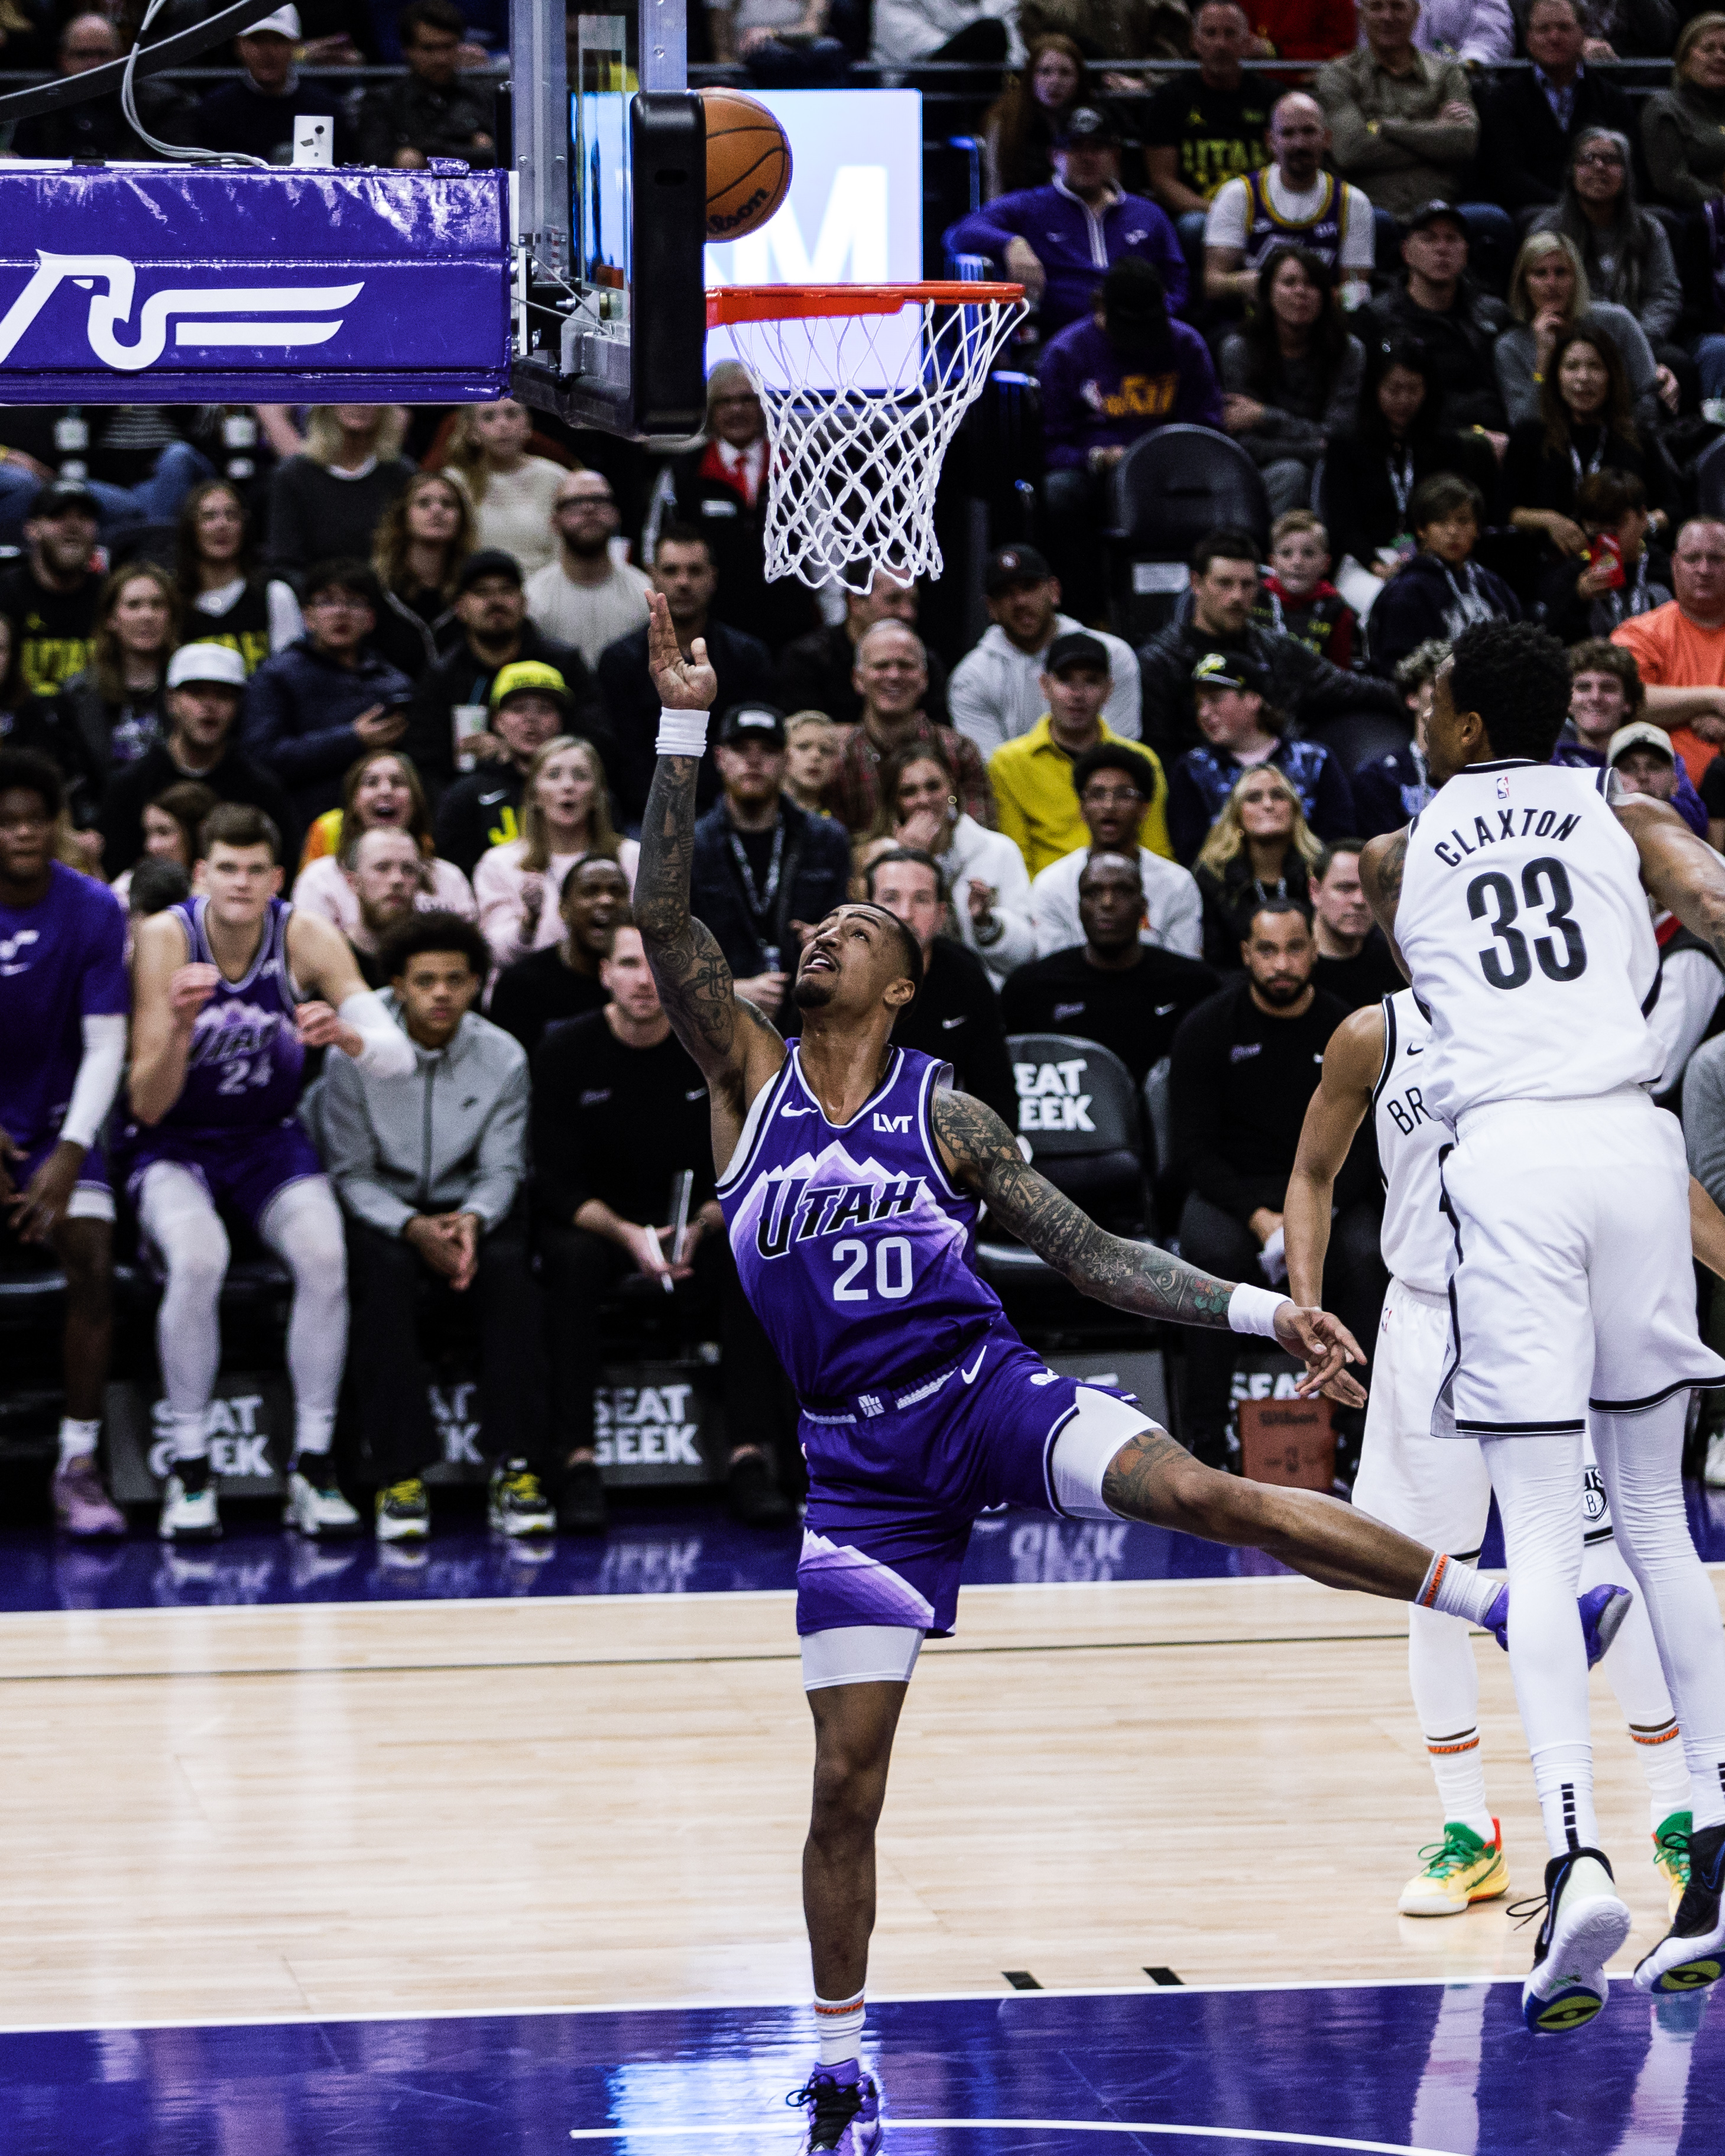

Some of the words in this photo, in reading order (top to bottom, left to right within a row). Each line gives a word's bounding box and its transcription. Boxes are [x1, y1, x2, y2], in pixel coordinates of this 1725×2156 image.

[707, 187, 769, 235] lson
[1434, 809, 1583, 867] CLAXTON
[1467, 857, 1588, 990] 33
[1013, 1059, 1088, 1096] EAT
[874, 1113, 913, 1133] LVT
[1019, 1094, 1097, 1132] EEK
[756, 1176, 927, 1259] UTAH
[832, 1237, 913, 1301] 20
[151, 1395, 264, 1438] SAT
[150, 1435, 274, 1477] GEK
[1585, 1468, 1604, 1489] TS
